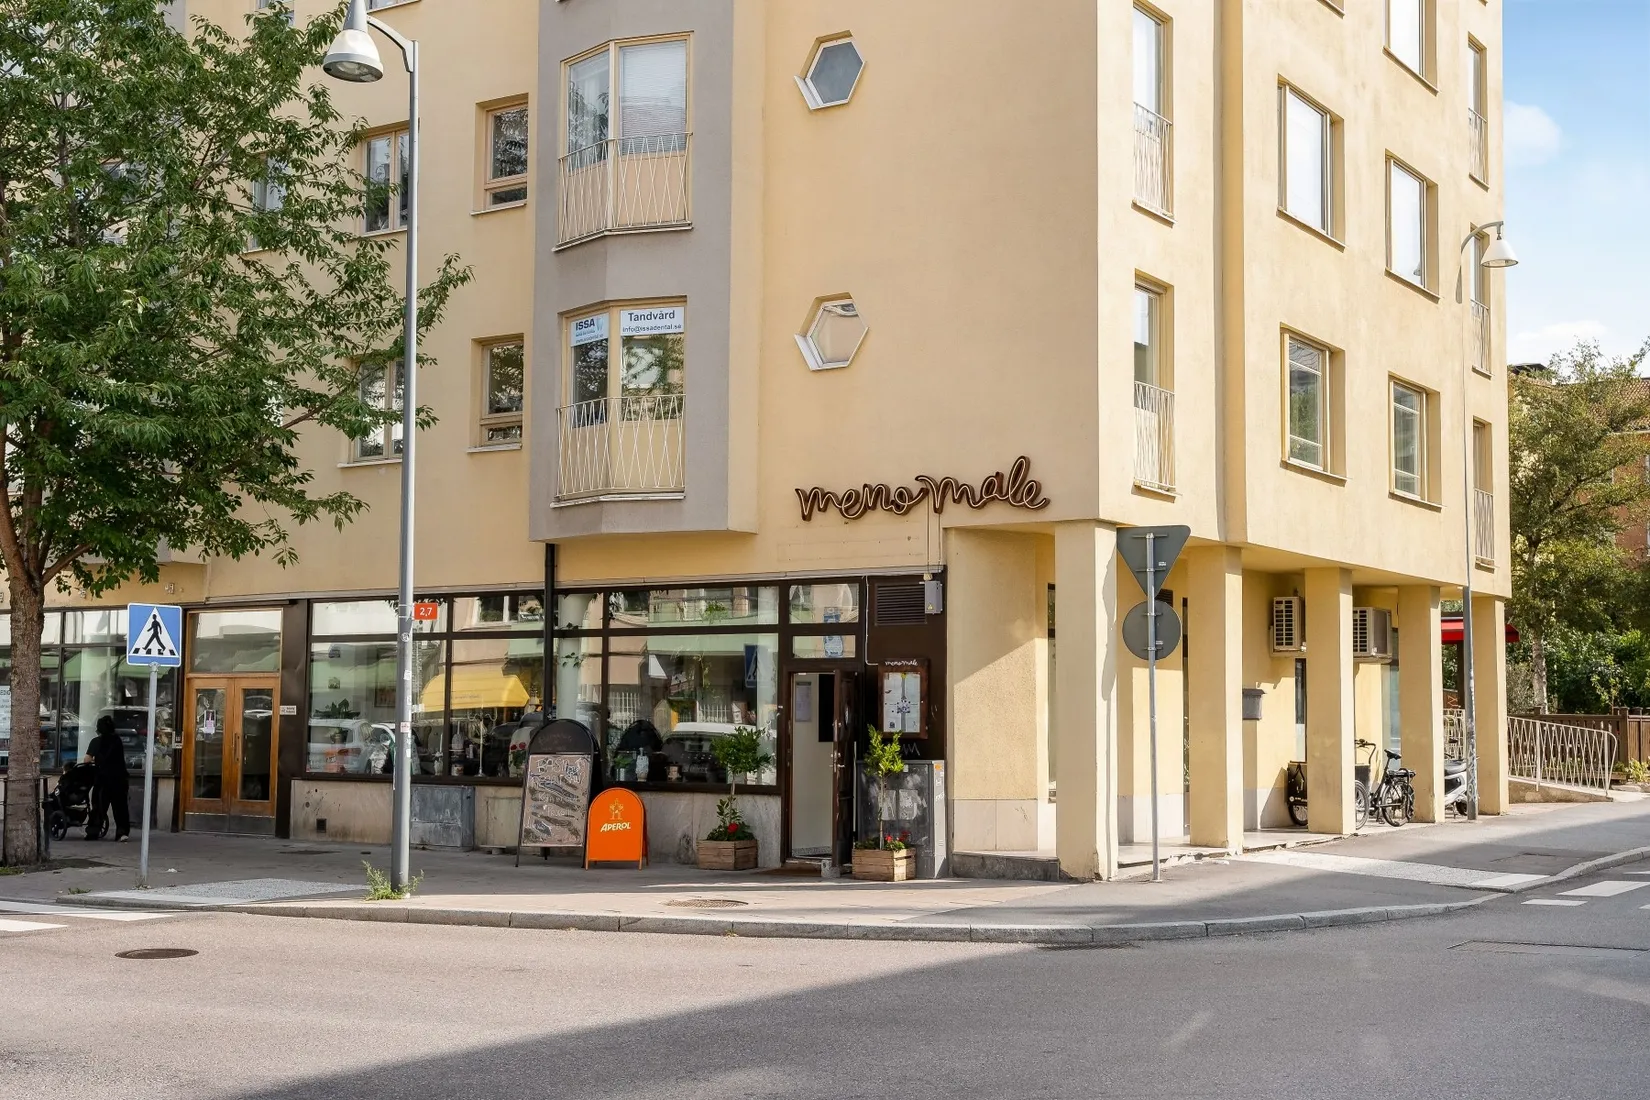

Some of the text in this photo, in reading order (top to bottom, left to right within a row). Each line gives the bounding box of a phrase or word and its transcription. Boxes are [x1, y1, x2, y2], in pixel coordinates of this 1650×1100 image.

[628, 310, 675, 322] Tandvård
[575, 318, 595, 331] ISSA
[419, 607, 433, 617] 2,7
[600, 822, 632, 832] APEROL
